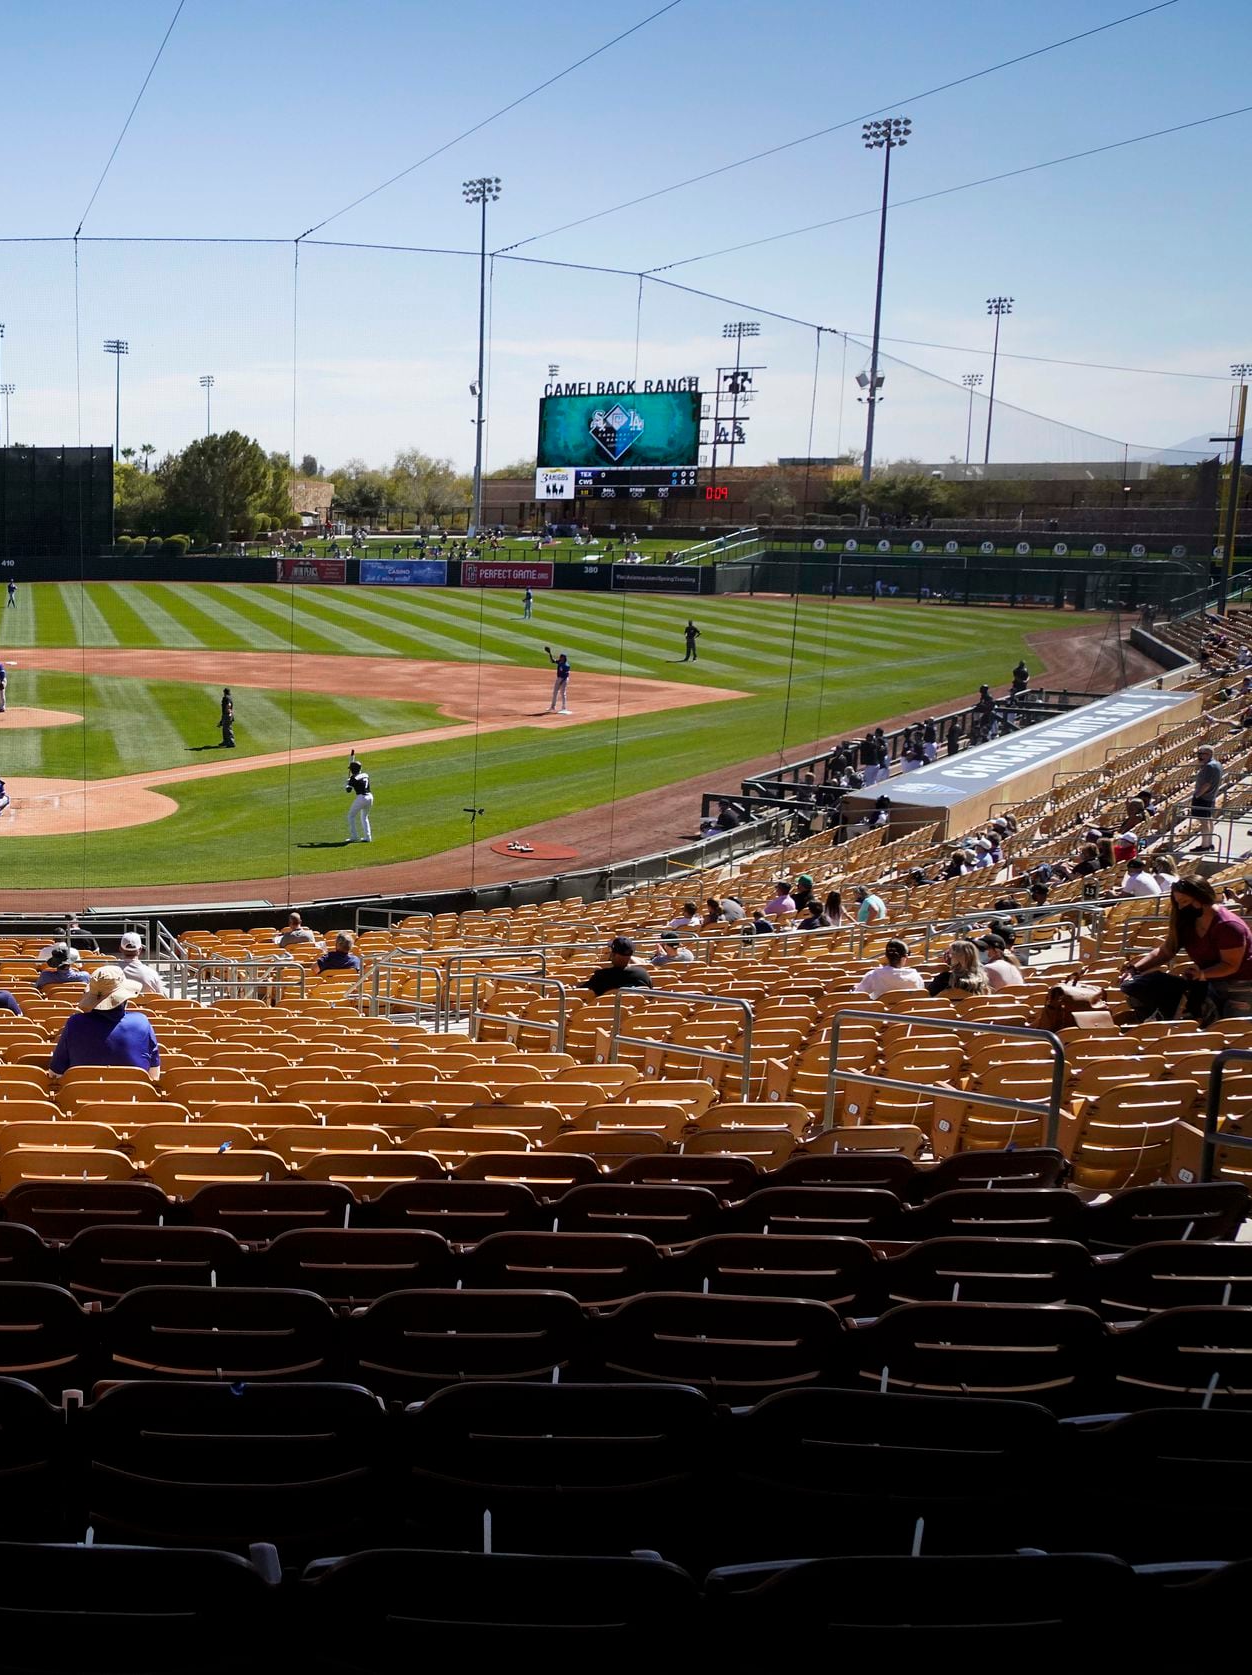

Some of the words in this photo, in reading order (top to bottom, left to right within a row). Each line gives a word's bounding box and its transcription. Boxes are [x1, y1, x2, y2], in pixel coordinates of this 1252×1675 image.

[544, 379, 636, 398] CAMELBACK
[644, 376, 699, 393] RANCH
[541, 474, 549, 483] 3
[706, 486, 728, 500] 0:09
[1, 559, 15, 567] 410
[388, 567, 410, 575] CASINO
[479, 569, 512, 579] PERFECT
[583, 566, 599, 574] 380
[940, 739, 1063, 778] CHICAGO
[1035, 715, 1122, 738] WHITE
[1094, 702, 1154, 716] SOX
[362, 778, 369, 789] 7
[1085, 887, 1095, 895] 13
